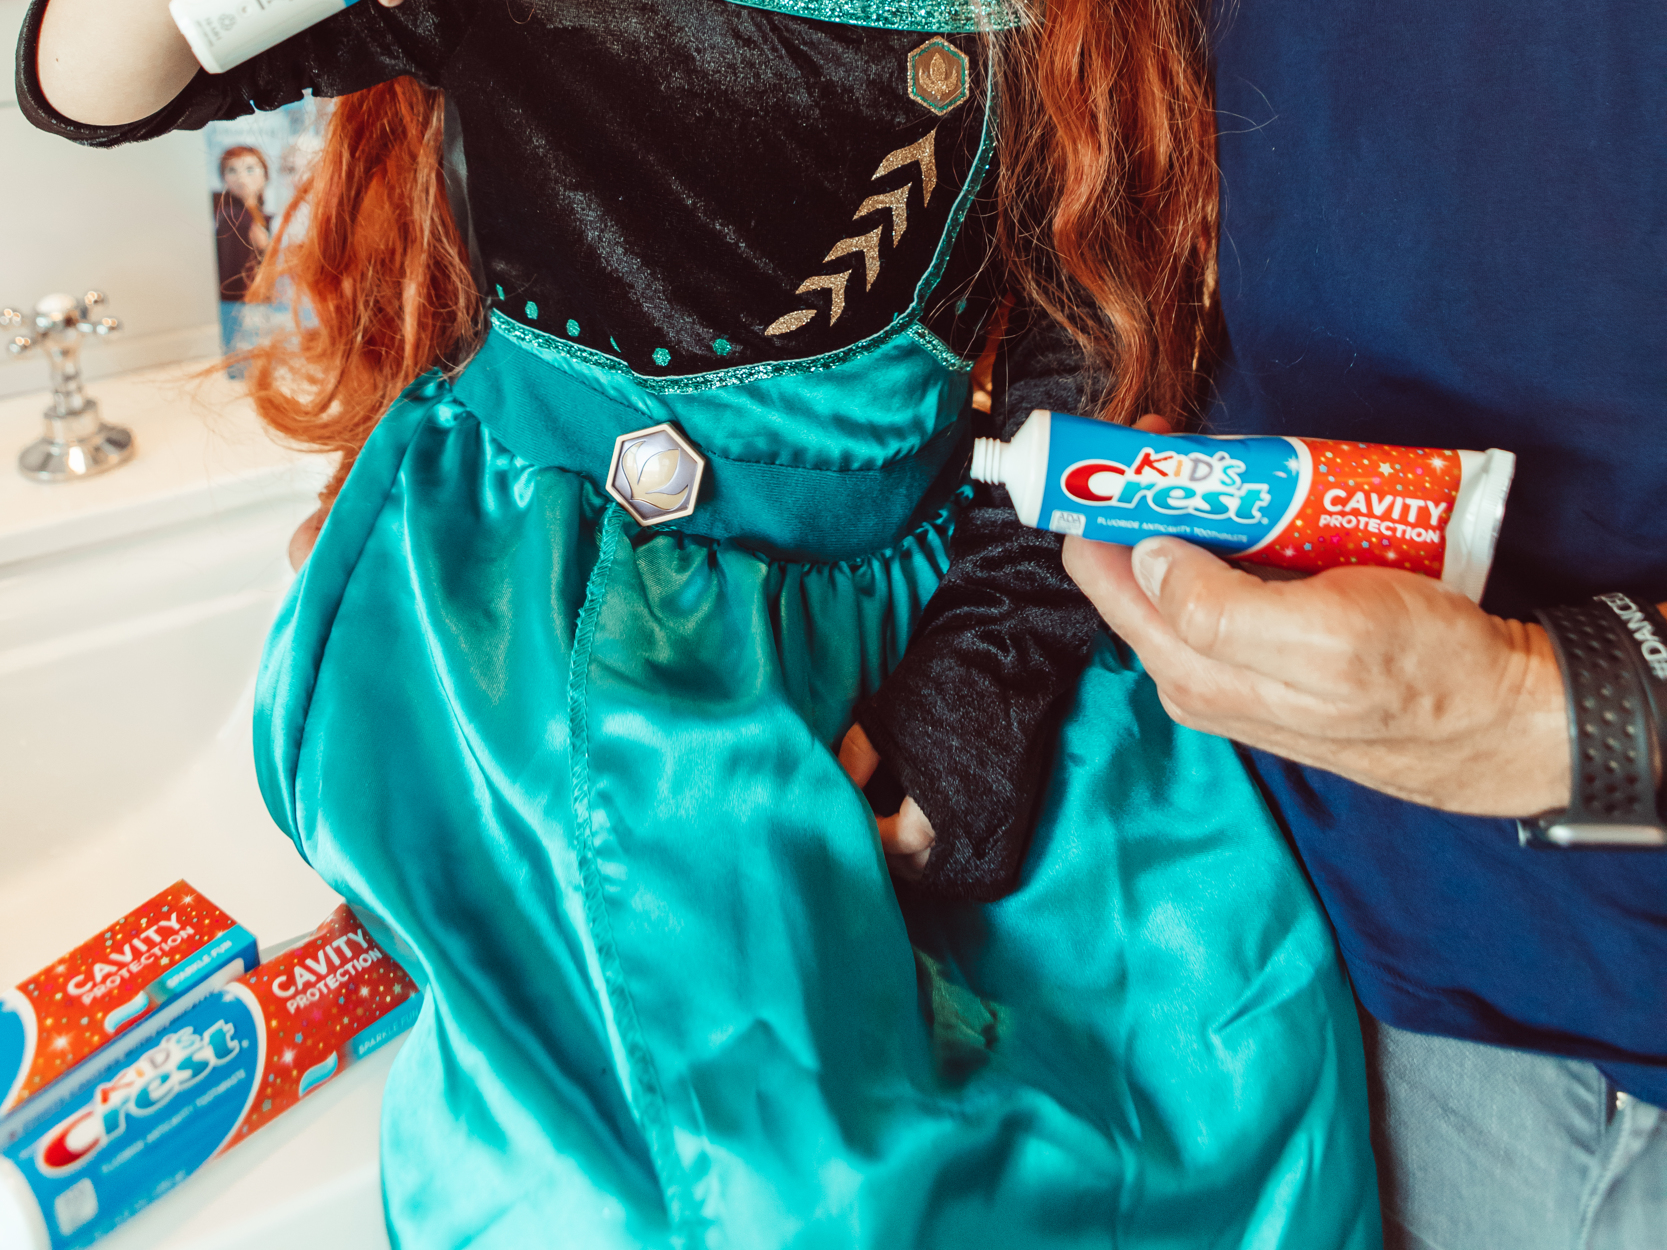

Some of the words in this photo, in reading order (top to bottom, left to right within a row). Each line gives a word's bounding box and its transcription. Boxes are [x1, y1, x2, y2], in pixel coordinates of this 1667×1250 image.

[1063, 462, 1264, 520] Crest
[1322, 488, 1448, 527] CAVITY
[1097, 516, 1140, 530] FLUORIDE
[1318, 514, 1442, 544] PROTECTION
[67, 911, 181, 996] CAVITY
[81, 925, 195, 1006] PROTECTION
[271, 928, 369, 998] CAVITY
[286, 947, 383, 1015] PROTECTION
[358, 1020, 399, 1056] SPARKLE
[42, 1025, 238, 1169] Crest
